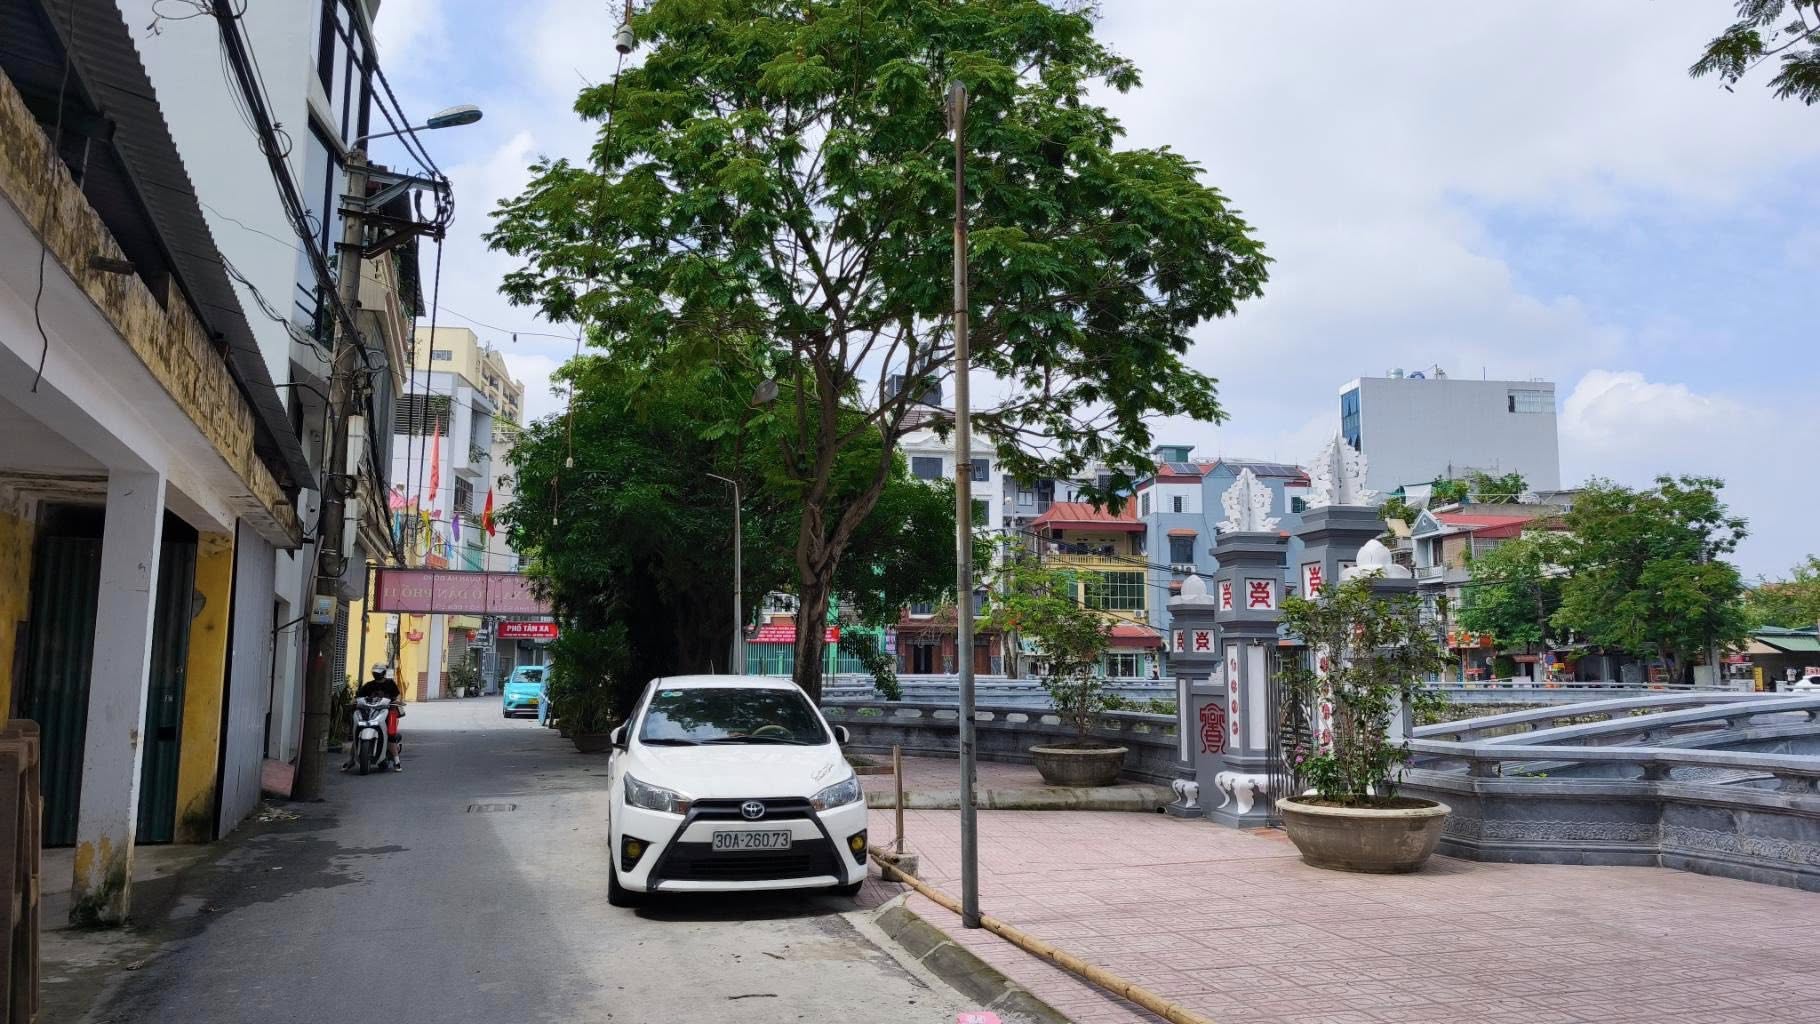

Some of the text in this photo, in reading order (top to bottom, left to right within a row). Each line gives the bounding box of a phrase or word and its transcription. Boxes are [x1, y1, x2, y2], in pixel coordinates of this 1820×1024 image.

[507, 624, 522, 632] PHỐ
[523, 624, 538, 632] TÂN
[715, 832, 789, 849] 30A-260.73
